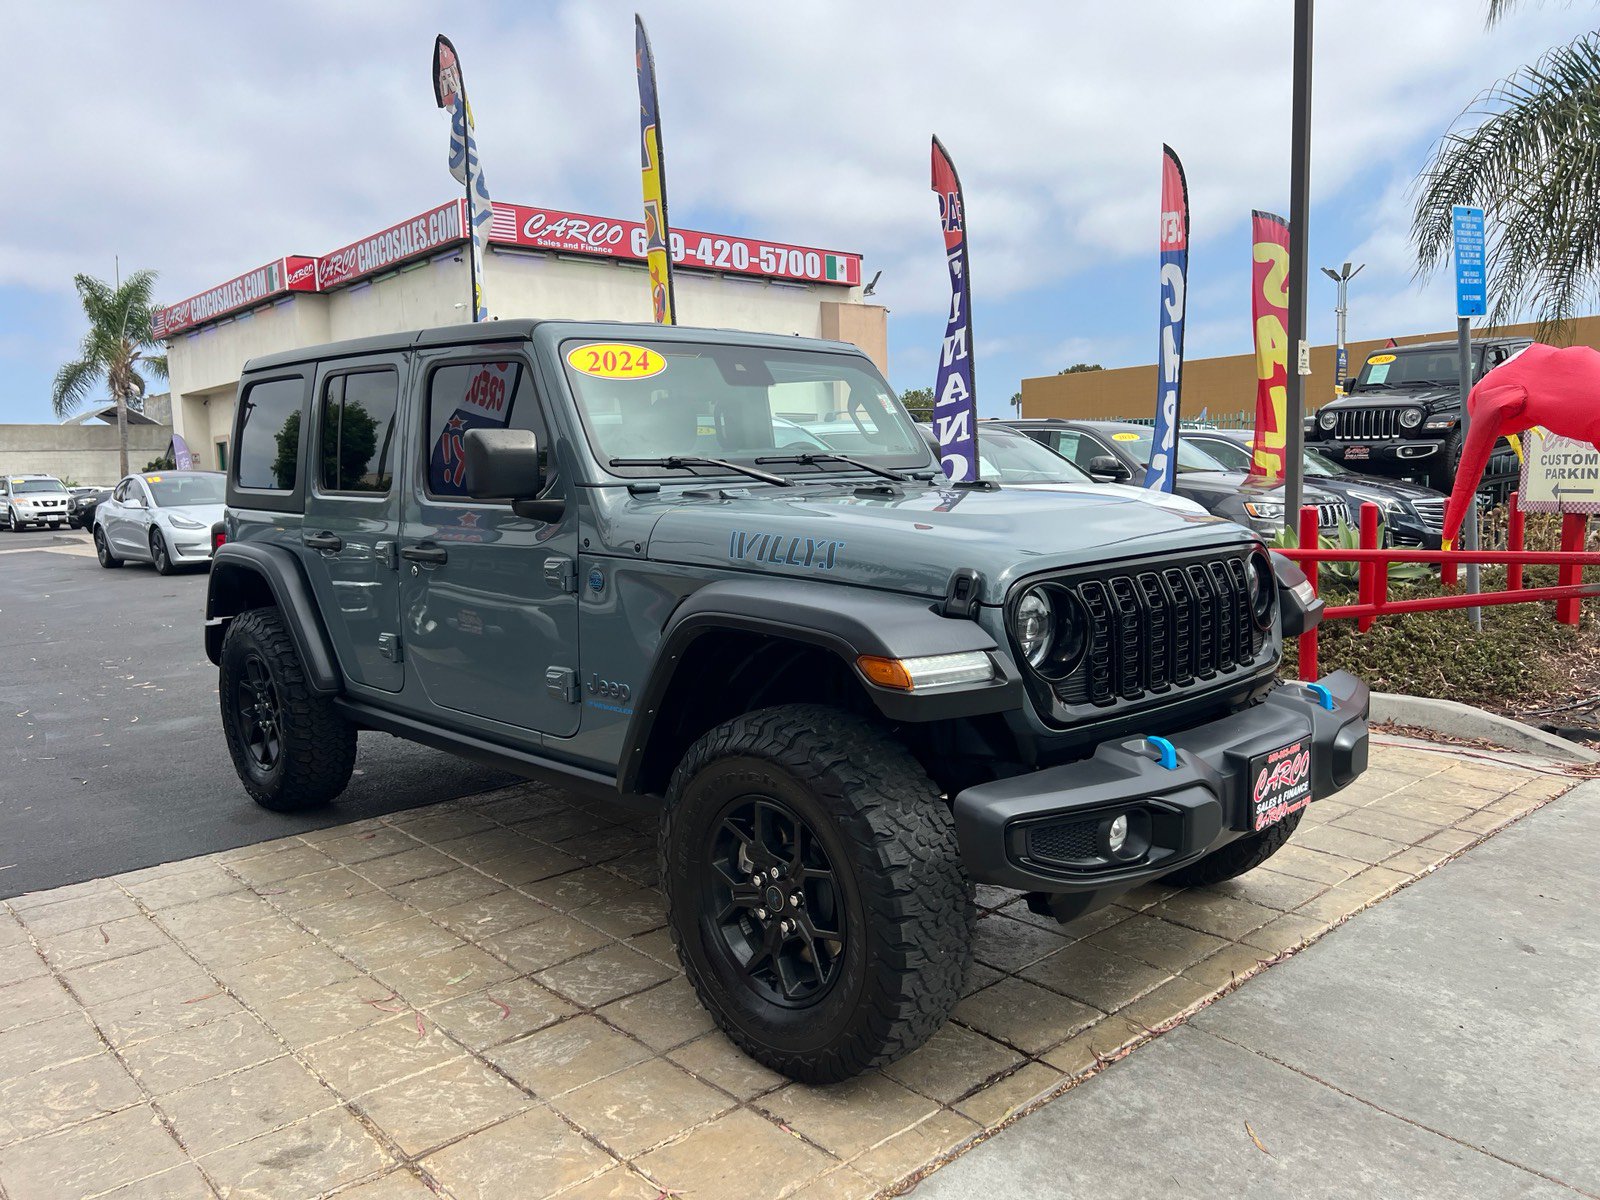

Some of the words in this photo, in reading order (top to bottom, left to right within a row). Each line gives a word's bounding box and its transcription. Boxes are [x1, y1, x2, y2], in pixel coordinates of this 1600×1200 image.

[318, 249, 356, 283] CARCO
[357, 204, 459, 272] CARCOSALES.COM
[523, 213, 624, 246] CARCO
[537, 238, 561, 247] Sales
[563, 241, 578, 249] and
[580, 243, 613, 254] Finance
[630, 227, 821, 279] 69-420-5700
[287, 263, 314, 284] CARCO
[190, 269, 267, 322] CARCOSALES.COM
[586, 350, 650, 373] 2024
[1541, 454, 1599, 466] CUSTOM
[729, 530, 846, 570] WILLYS
[586, 672, 631, 706] Jeep
[1253, 750, 1310, 803] CARCO
[1256, 796, 1277, 814] SALES
[1283, 781, 1309, 801] FINANCE
[1255, 801, 1288, 831] CARCO
